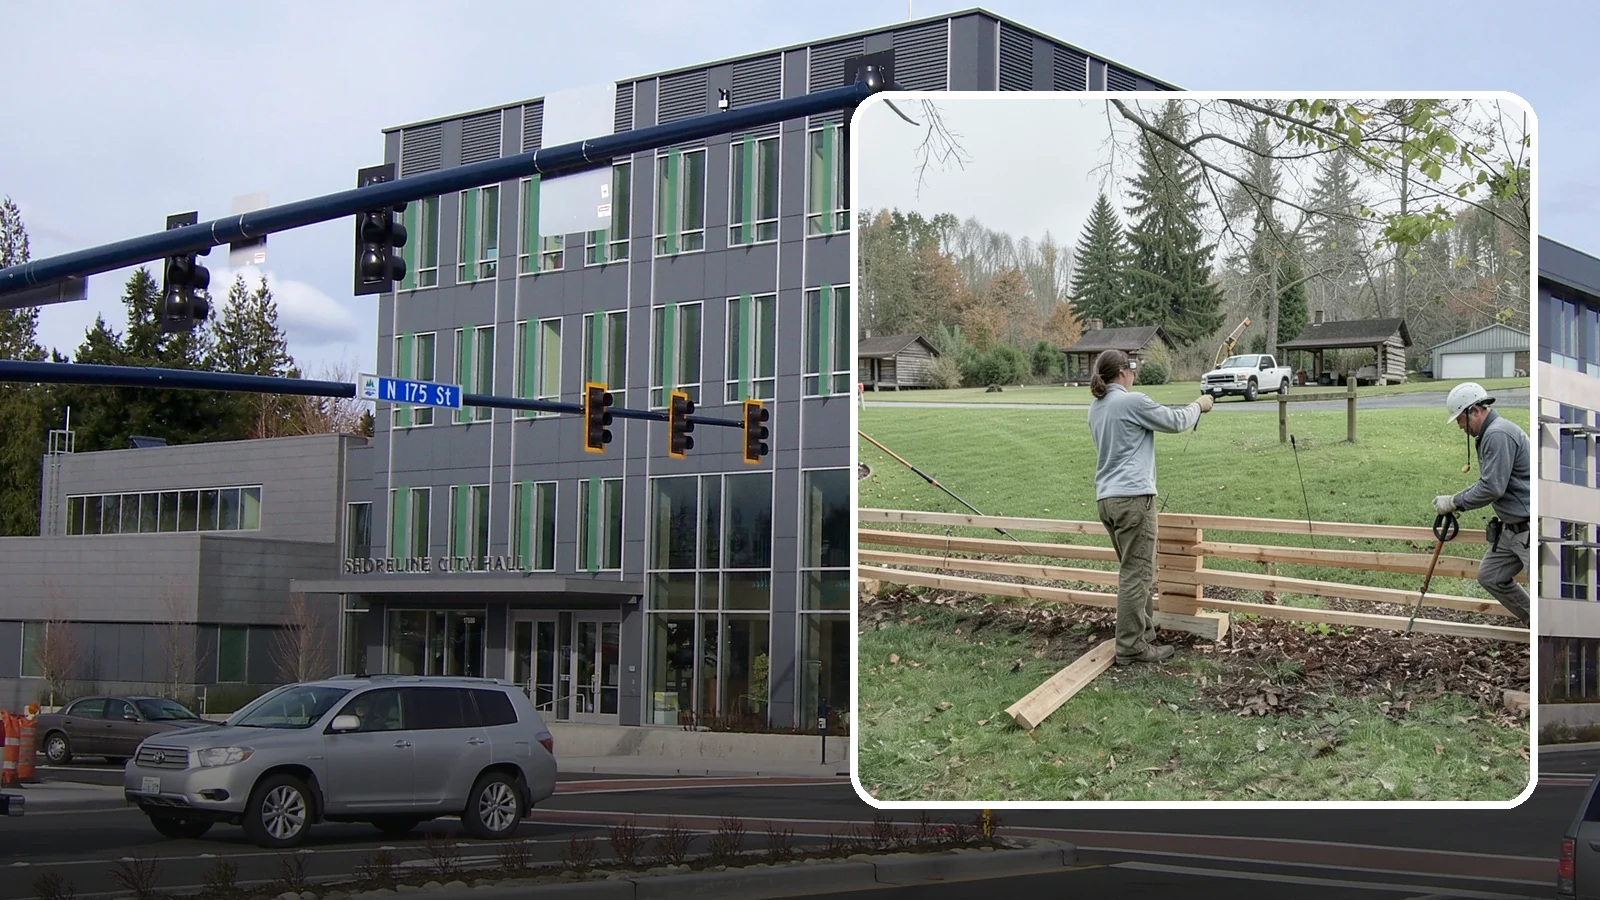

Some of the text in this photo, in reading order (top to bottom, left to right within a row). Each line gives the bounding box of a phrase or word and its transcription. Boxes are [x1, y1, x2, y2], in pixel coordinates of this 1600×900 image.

[387, 380, 451, 406] N 175 St
[343, 555, 525, 574] SHORELINE CITY HALL
